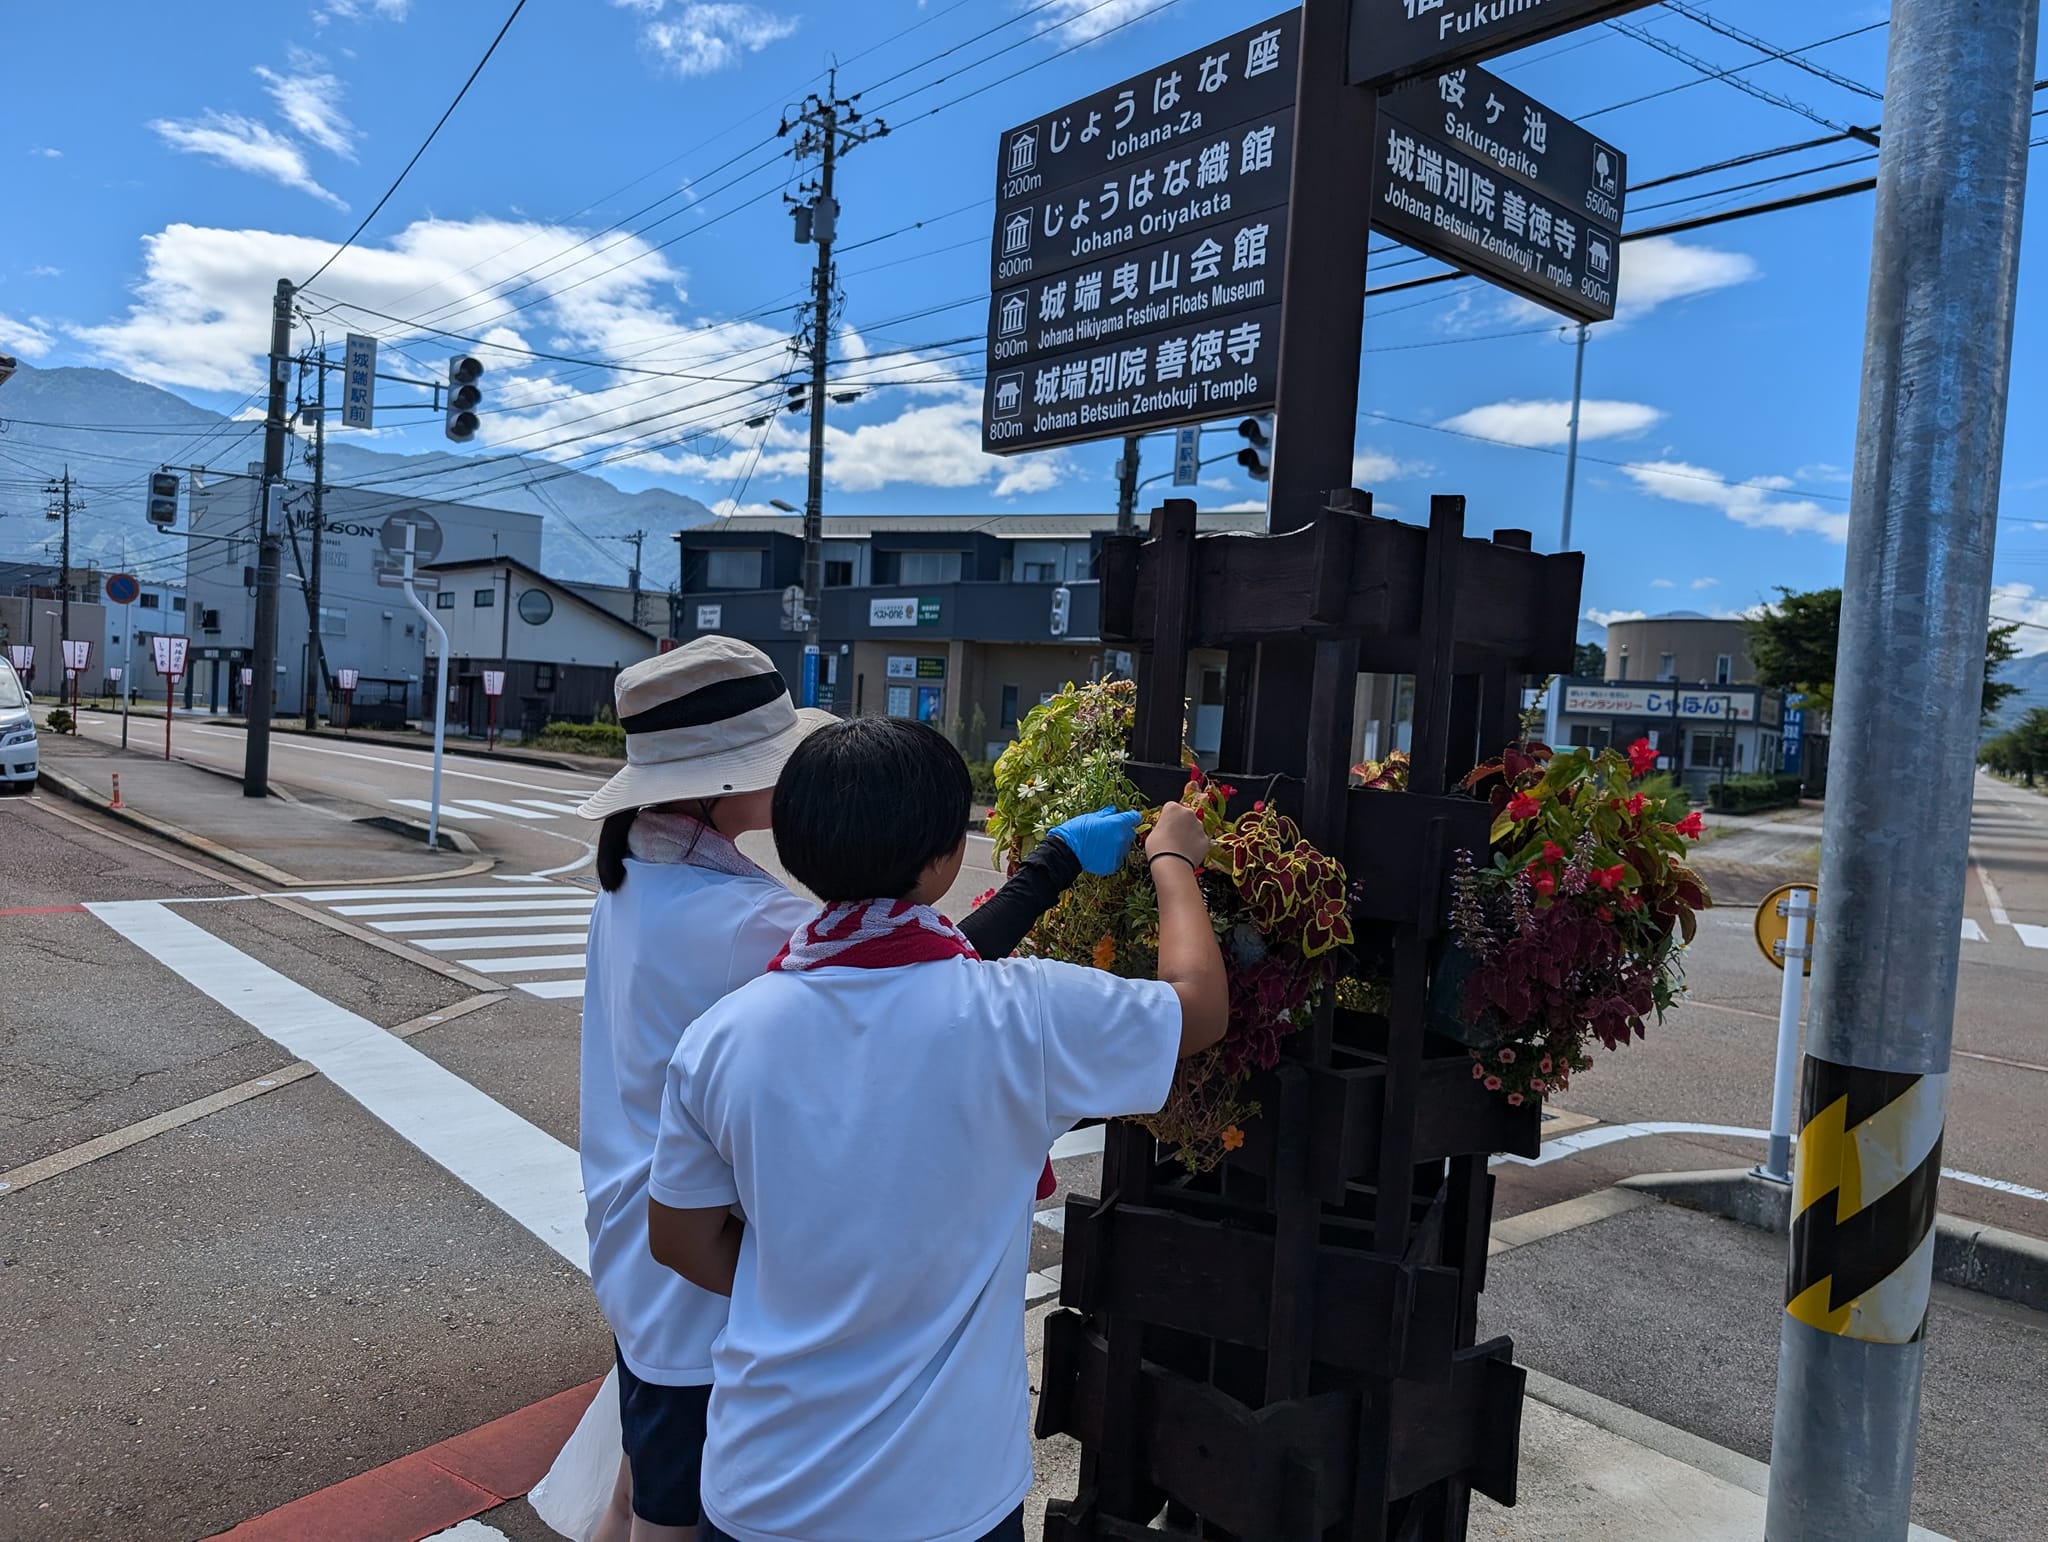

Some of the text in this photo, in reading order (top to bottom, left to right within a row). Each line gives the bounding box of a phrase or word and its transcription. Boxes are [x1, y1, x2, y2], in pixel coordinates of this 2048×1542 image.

[1439, 0, 1551, 40] Fukum
[1050, 28, 1281, 153] じょうはな座
[1107, 109, 1202, 161] Johana-Za
[1445, 112, 1538, 179] Sakuragaike
[1002, 174, 1041, 199] 1200m
[1044, 125, 1275, 237] じょうはな織館
[1387, 128, 1576, 260] 城端別院 善徳寺
[1585, 190, 1618, 222] 5500m
[1072, 193, 1231, 256] Johana Oriyakata
[1385, 182, 1572, 288] Johana Betsuin Zentokuji Tmple
[999, 257, 1032, 279] 900m
[1039, 224, 1269, 322] 城端曳山会館
[1581, 277, 1610, 306] 900m
[1038, 279, 1265, 350] Johana Hikiyama Festival Floats Museum
[995, 339, 1027, 360] 900m
[1033, 322, 1261, 406] 城端別院 善徳寺
[350, 351, 369, 423] 城端駅前
[1033, 373, 1257, 433] Johana Betsuin Zentokuji Temple
[989, 421, 1023, 440] 800m
